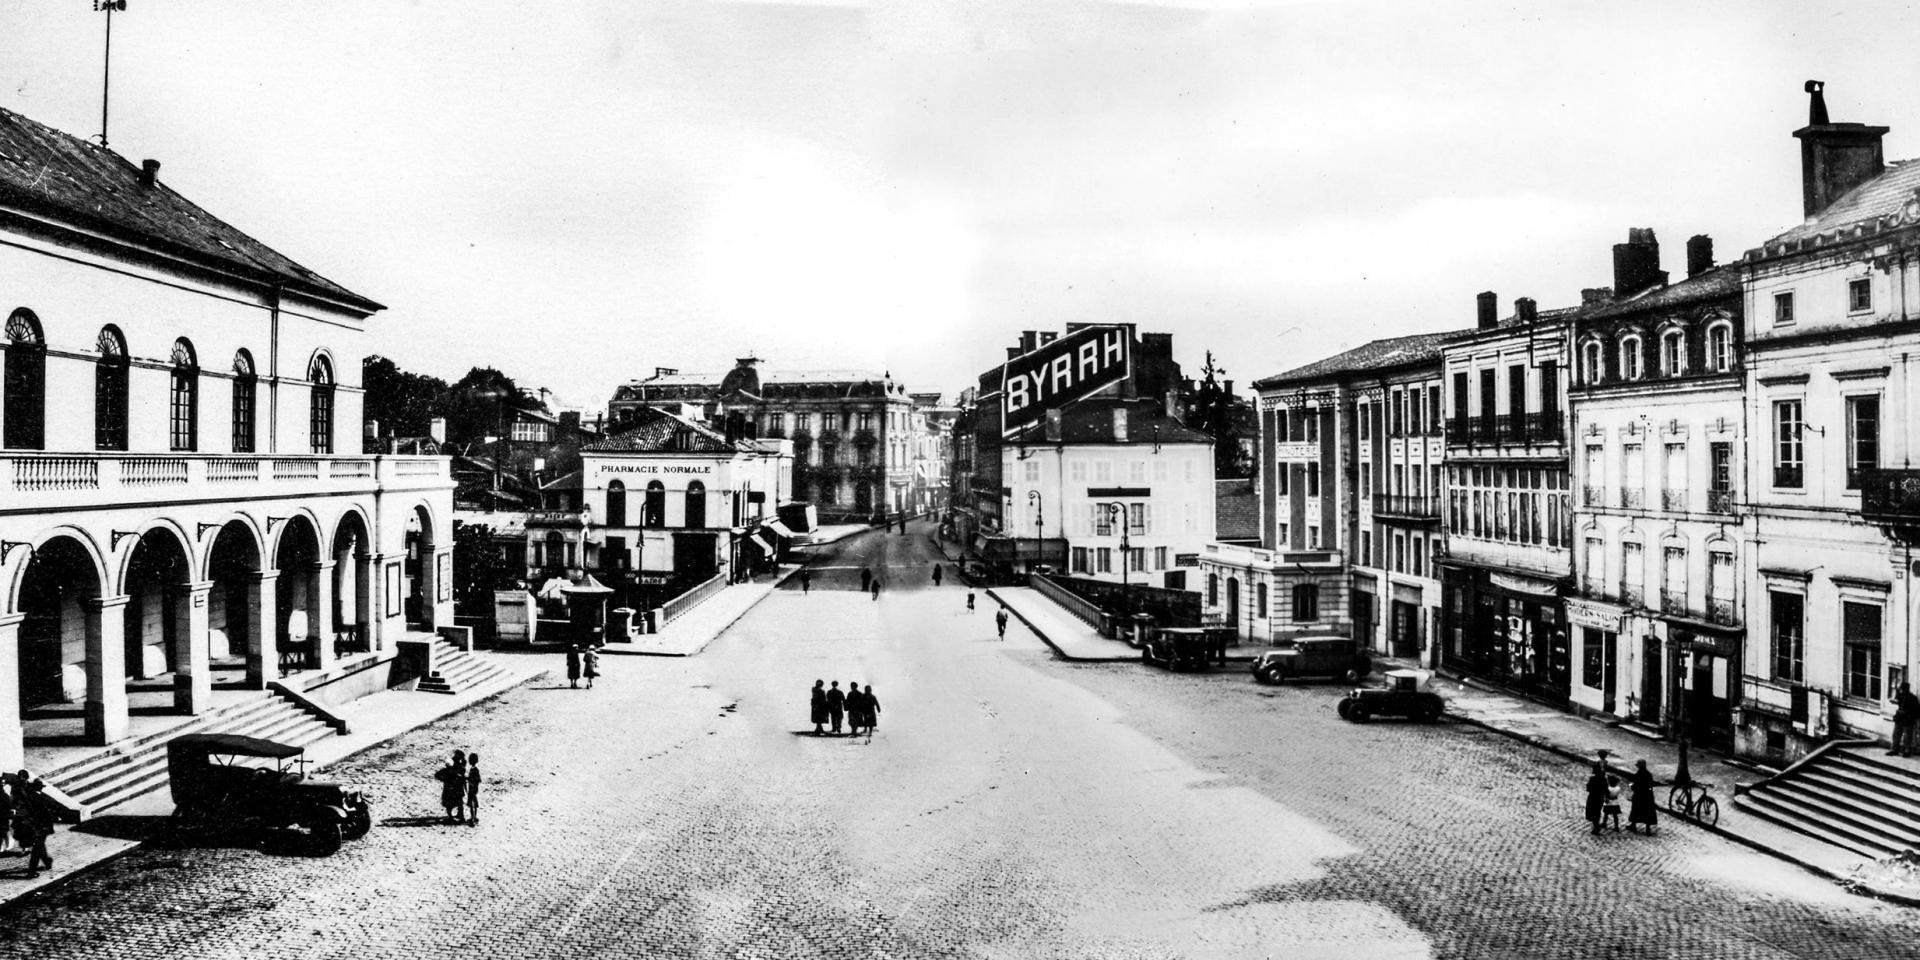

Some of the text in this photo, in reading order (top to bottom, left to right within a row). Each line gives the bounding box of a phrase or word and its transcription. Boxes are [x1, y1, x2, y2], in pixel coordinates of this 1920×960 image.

[1007, 330, 1122, 414] BYRRH
[601, 465, 711, 474] PHARMACIE NORMALE
